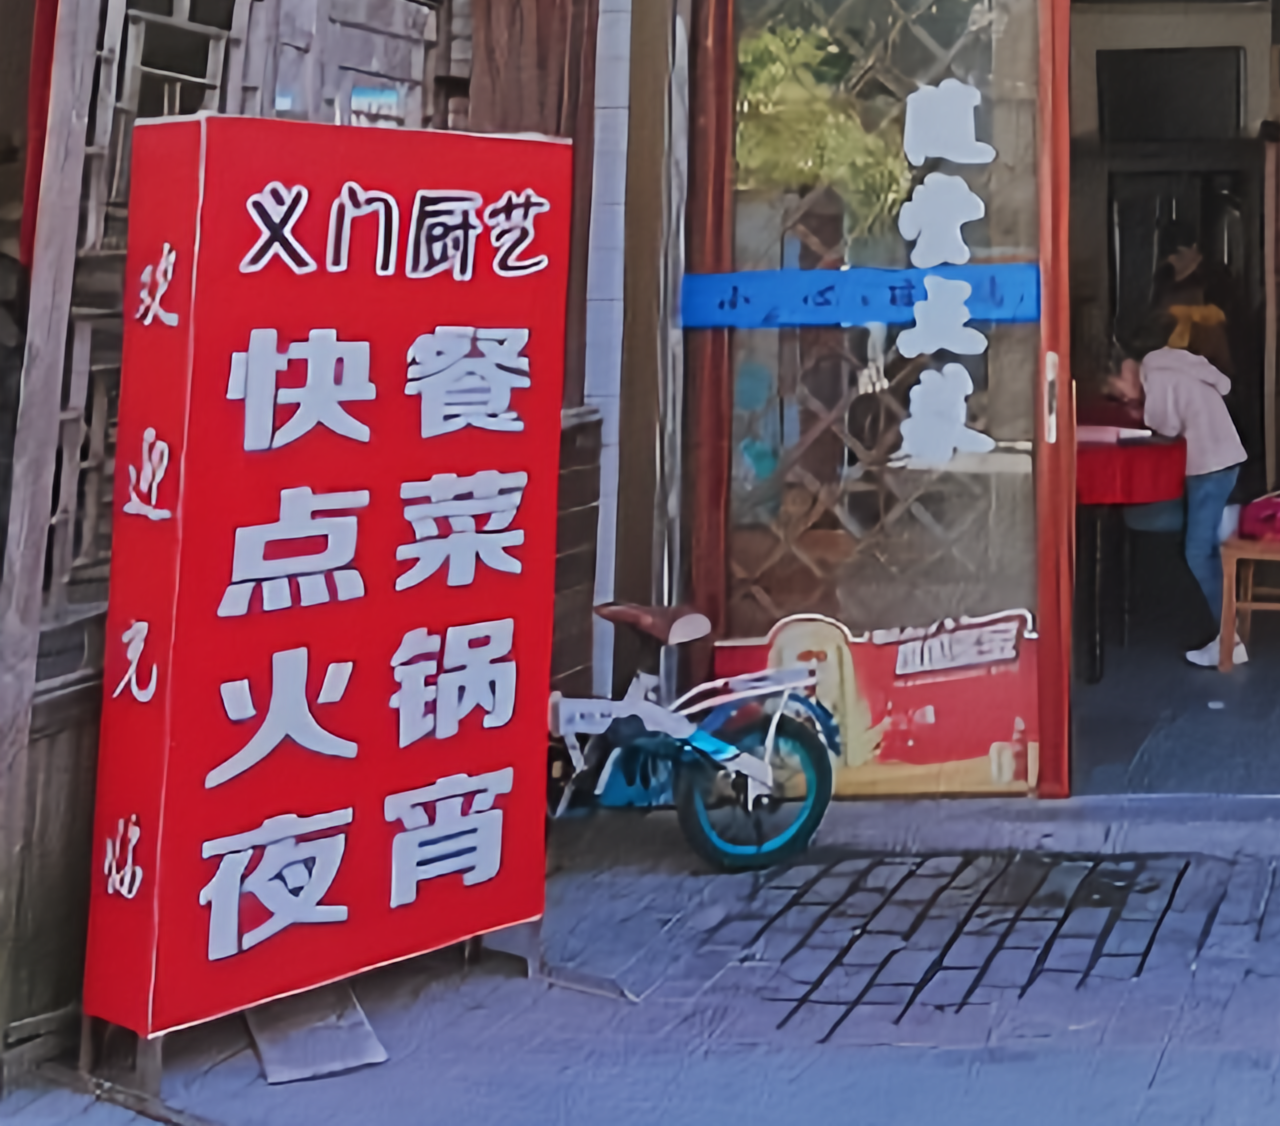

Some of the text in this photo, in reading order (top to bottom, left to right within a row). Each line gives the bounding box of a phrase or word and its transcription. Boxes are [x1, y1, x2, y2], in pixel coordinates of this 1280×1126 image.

[240, 181, 550, 281] 义门厨艺
[226, 326, 531, 452] 快餐
[215, 471, 528, 617] 点菜
[204, 619, 517, 790] 火锅
[199, 767, 514, 962] 夜宵
